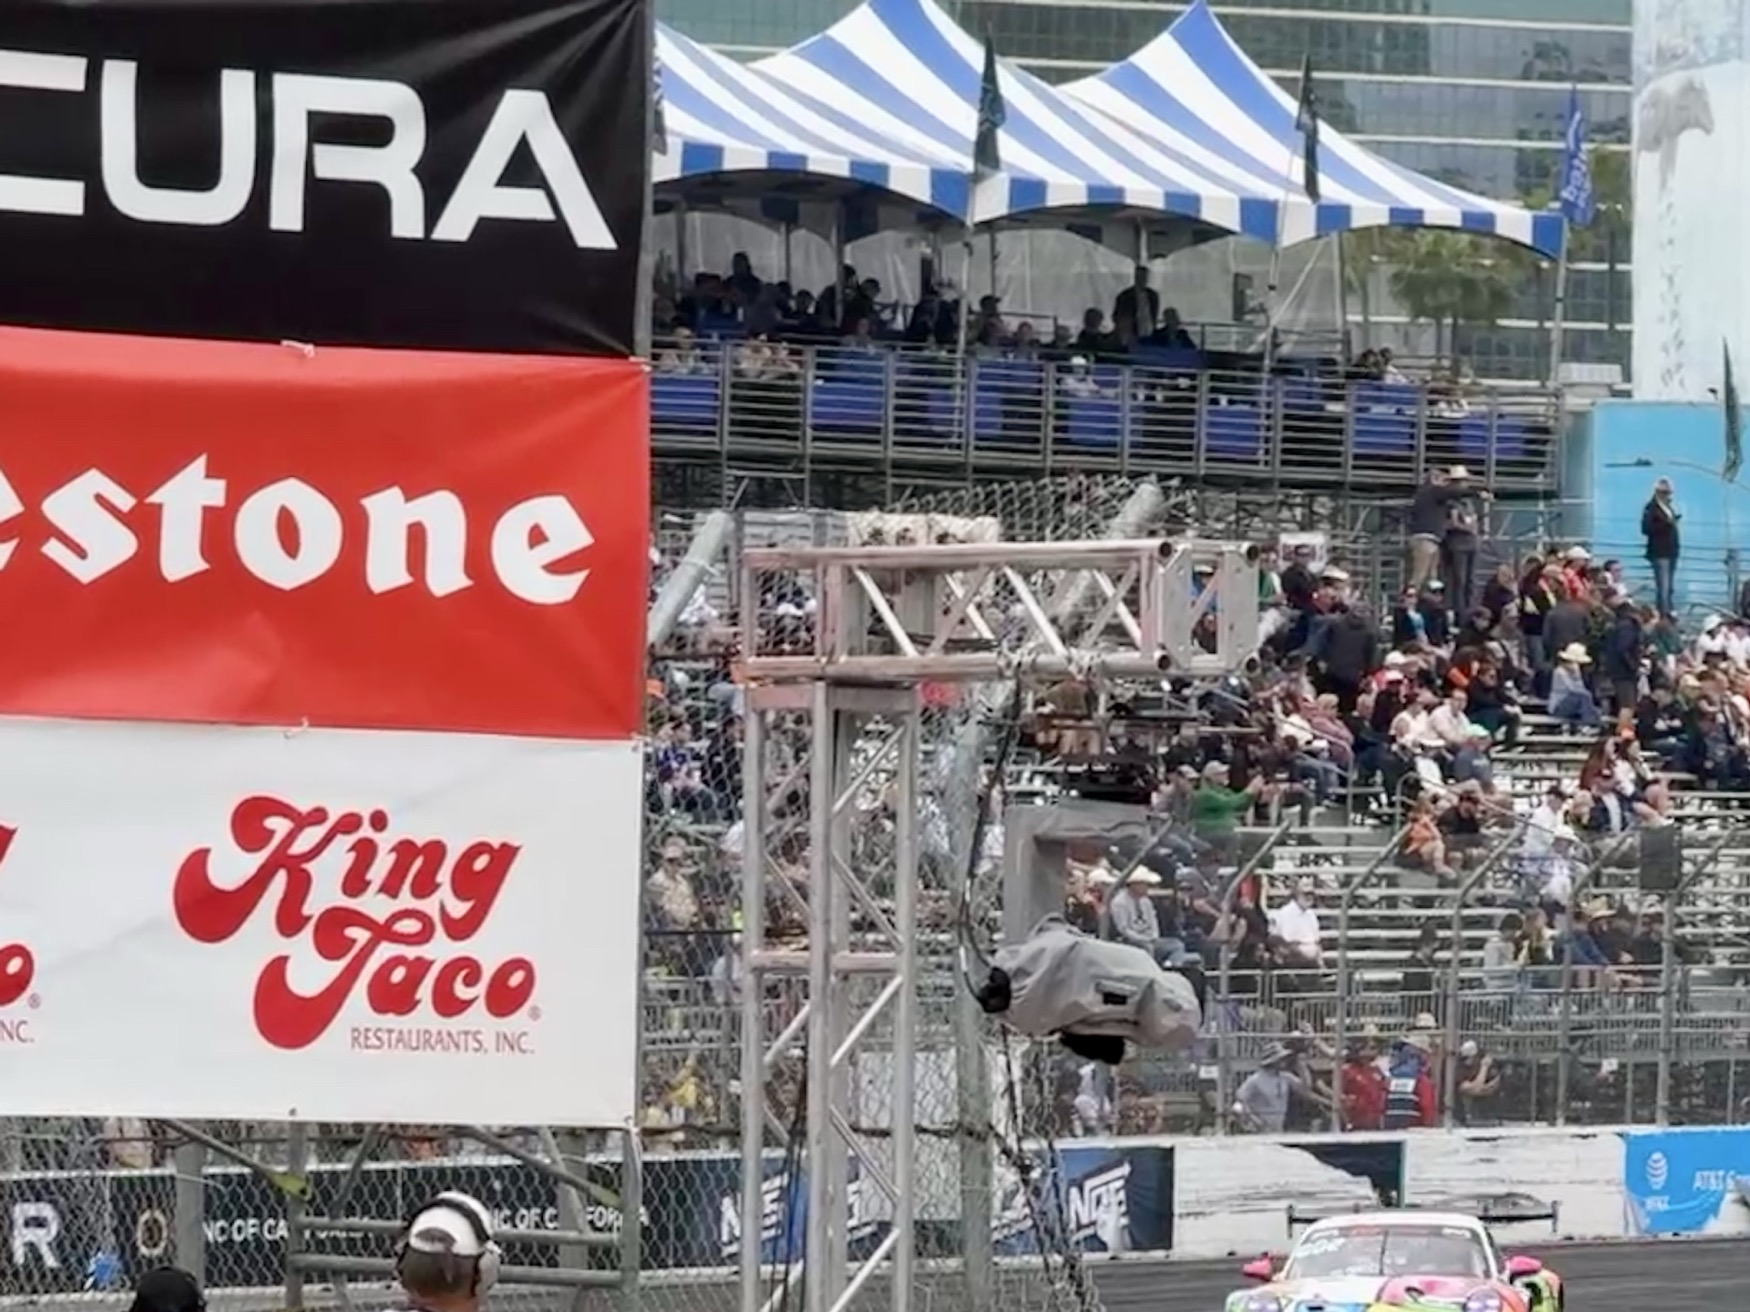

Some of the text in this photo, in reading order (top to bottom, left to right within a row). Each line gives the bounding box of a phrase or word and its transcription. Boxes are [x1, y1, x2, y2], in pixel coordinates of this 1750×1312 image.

[0, 452, 595, 605] stone
[173, 795, 523, 943] King
[253, 907, 536, 1050] Taco
[351, 1027, 535, 1055] RESTAURANTS, INC.
